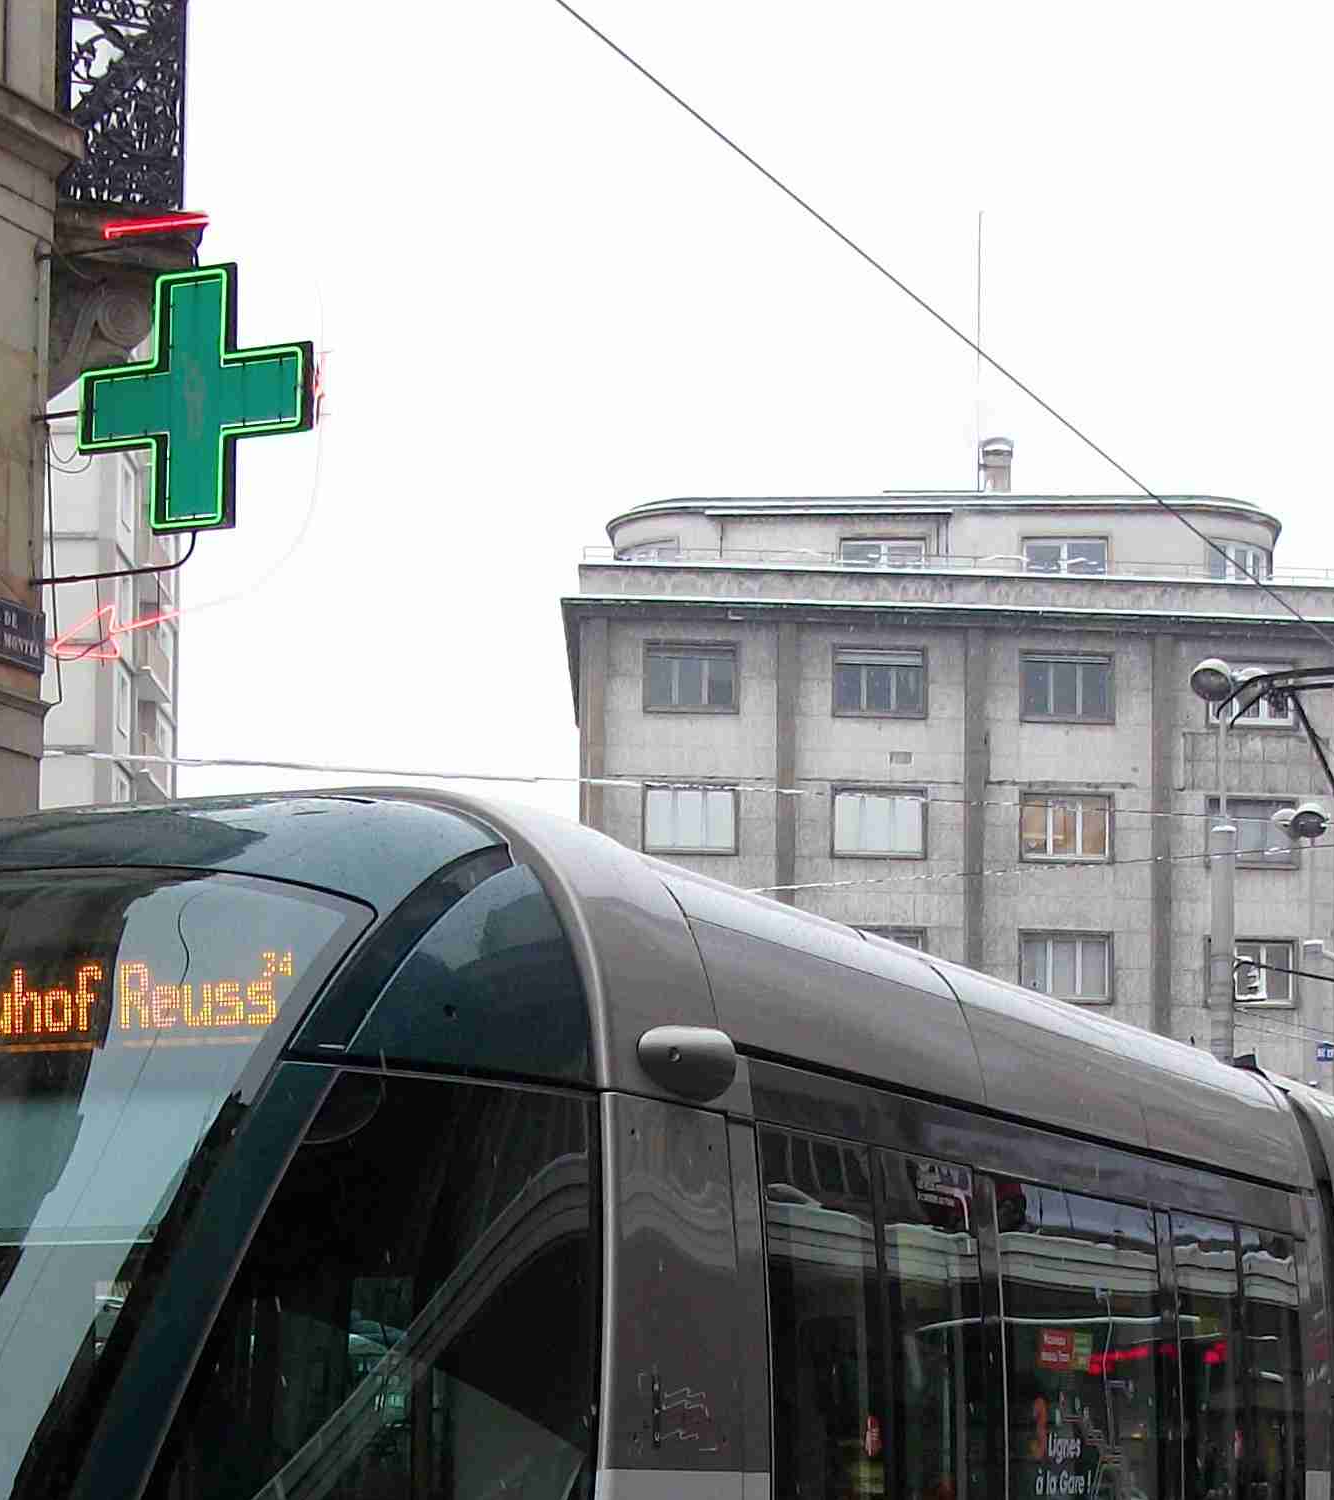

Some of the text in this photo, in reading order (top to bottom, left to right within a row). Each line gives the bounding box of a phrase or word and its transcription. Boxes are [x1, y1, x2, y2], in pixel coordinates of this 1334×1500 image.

[4, 610, 19, 629] DE
[119, 963, 279, 1030] Reuss
[1049, 1432, 1081, 1464] Lignes
[1046, 1470, 1057, 1495] la
[1060, 1469, 1085, 1495] Gare
